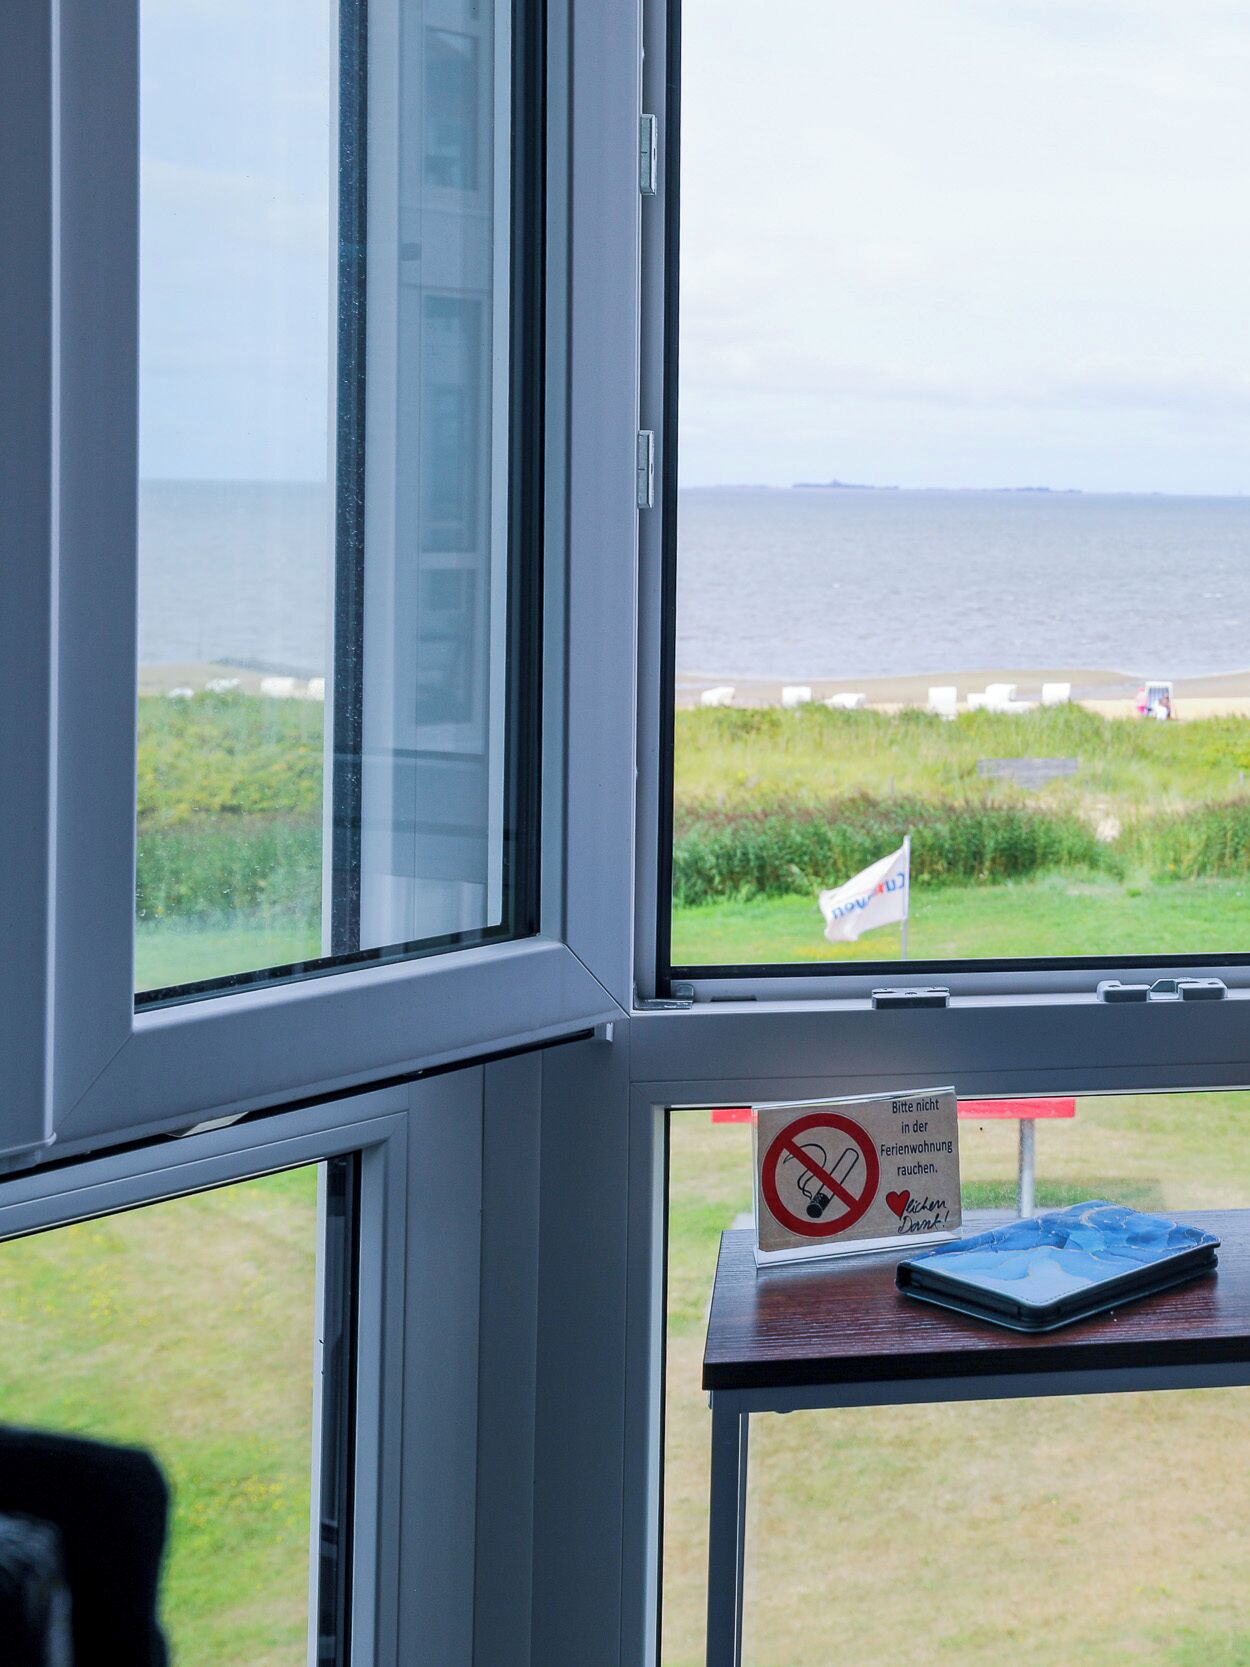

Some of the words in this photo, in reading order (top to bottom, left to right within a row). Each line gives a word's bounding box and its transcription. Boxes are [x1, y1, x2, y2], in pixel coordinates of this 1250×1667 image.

[892, 1101, 913, 1113] Bitte
[916, 1098, 940, 1112] nicht
[901, 1121, 910, 1134] in
[912, 1119, 928, 1133] der
[880, 1140, 953, 1157] Ferienwohnung
[897, 1161, 938, 1176] rauchen.
[906, 1196, 947, 1214] lichen
[897, 1209, 950, 1234] Dank!
